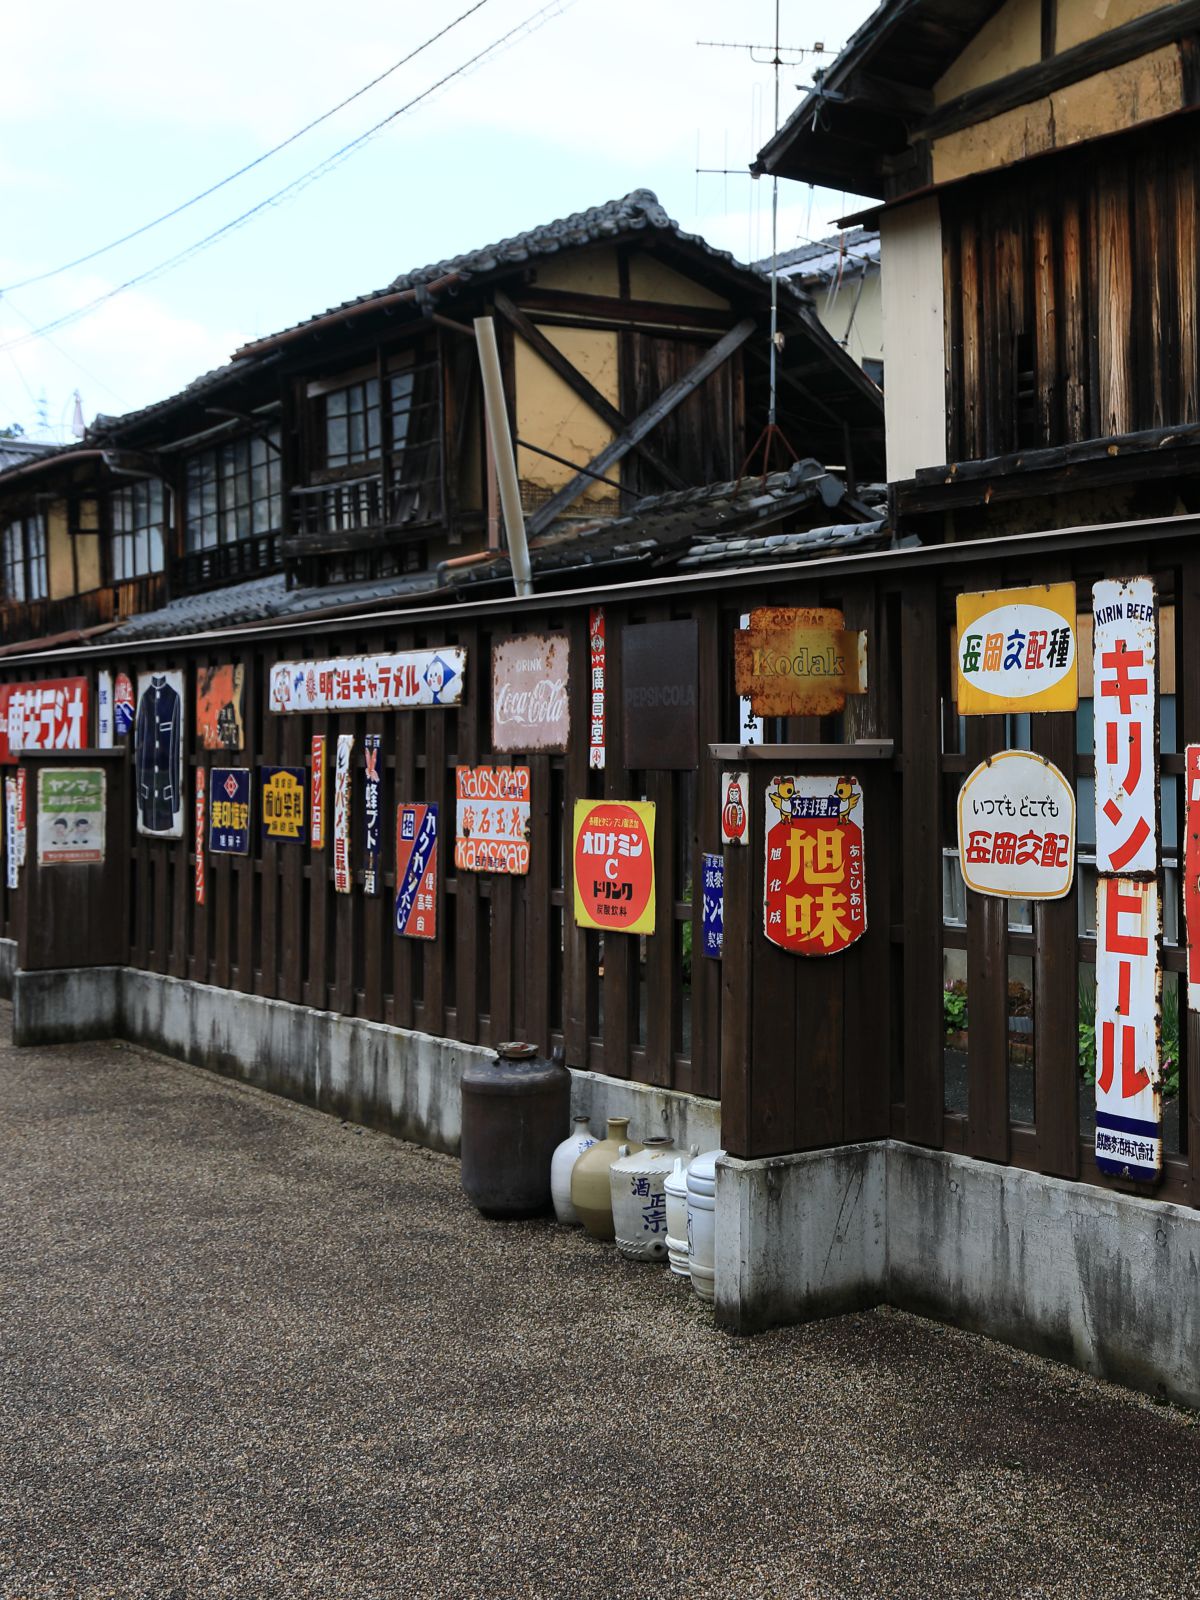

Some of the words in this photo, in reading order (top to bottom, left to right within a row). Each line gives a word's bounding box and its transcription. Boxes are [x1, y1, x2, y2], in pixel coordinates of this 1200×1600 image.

[1096, 603, 1123, 627] KIRIN
[1127, 603, 1153, 623] BEER
[752, 647, 846, 677] Kodak
[962, 627, 1071, 673] 長岡交配種
[516, 658, 542, 673] DRINK
[319, 665, 420, 701] 明治キャラメル
[49, 780, 97, 792] ヤンマー
[792, 799, 838, 816] お料理に
[973, 795, 1016, 817] いつでも
[1020, 796, 1059, 817] どこでも
[582, 831, 643, 857] オロナミン
[966, 829, 1070, 868] 長岡交配
[604, 858, 619, 880] C
[593, 880, 633, 901] ドリンク
[769, 848, 782, 924] 旭化成
[785, 827, 852, 947] 旭味
[850, 845, 861, 921] あさひあじ
[596, 904, 628, 917] 炭酸飲料
[630, 1177, 649, 1198] 酒
[642, 1193, 668, 1234] 正宗
